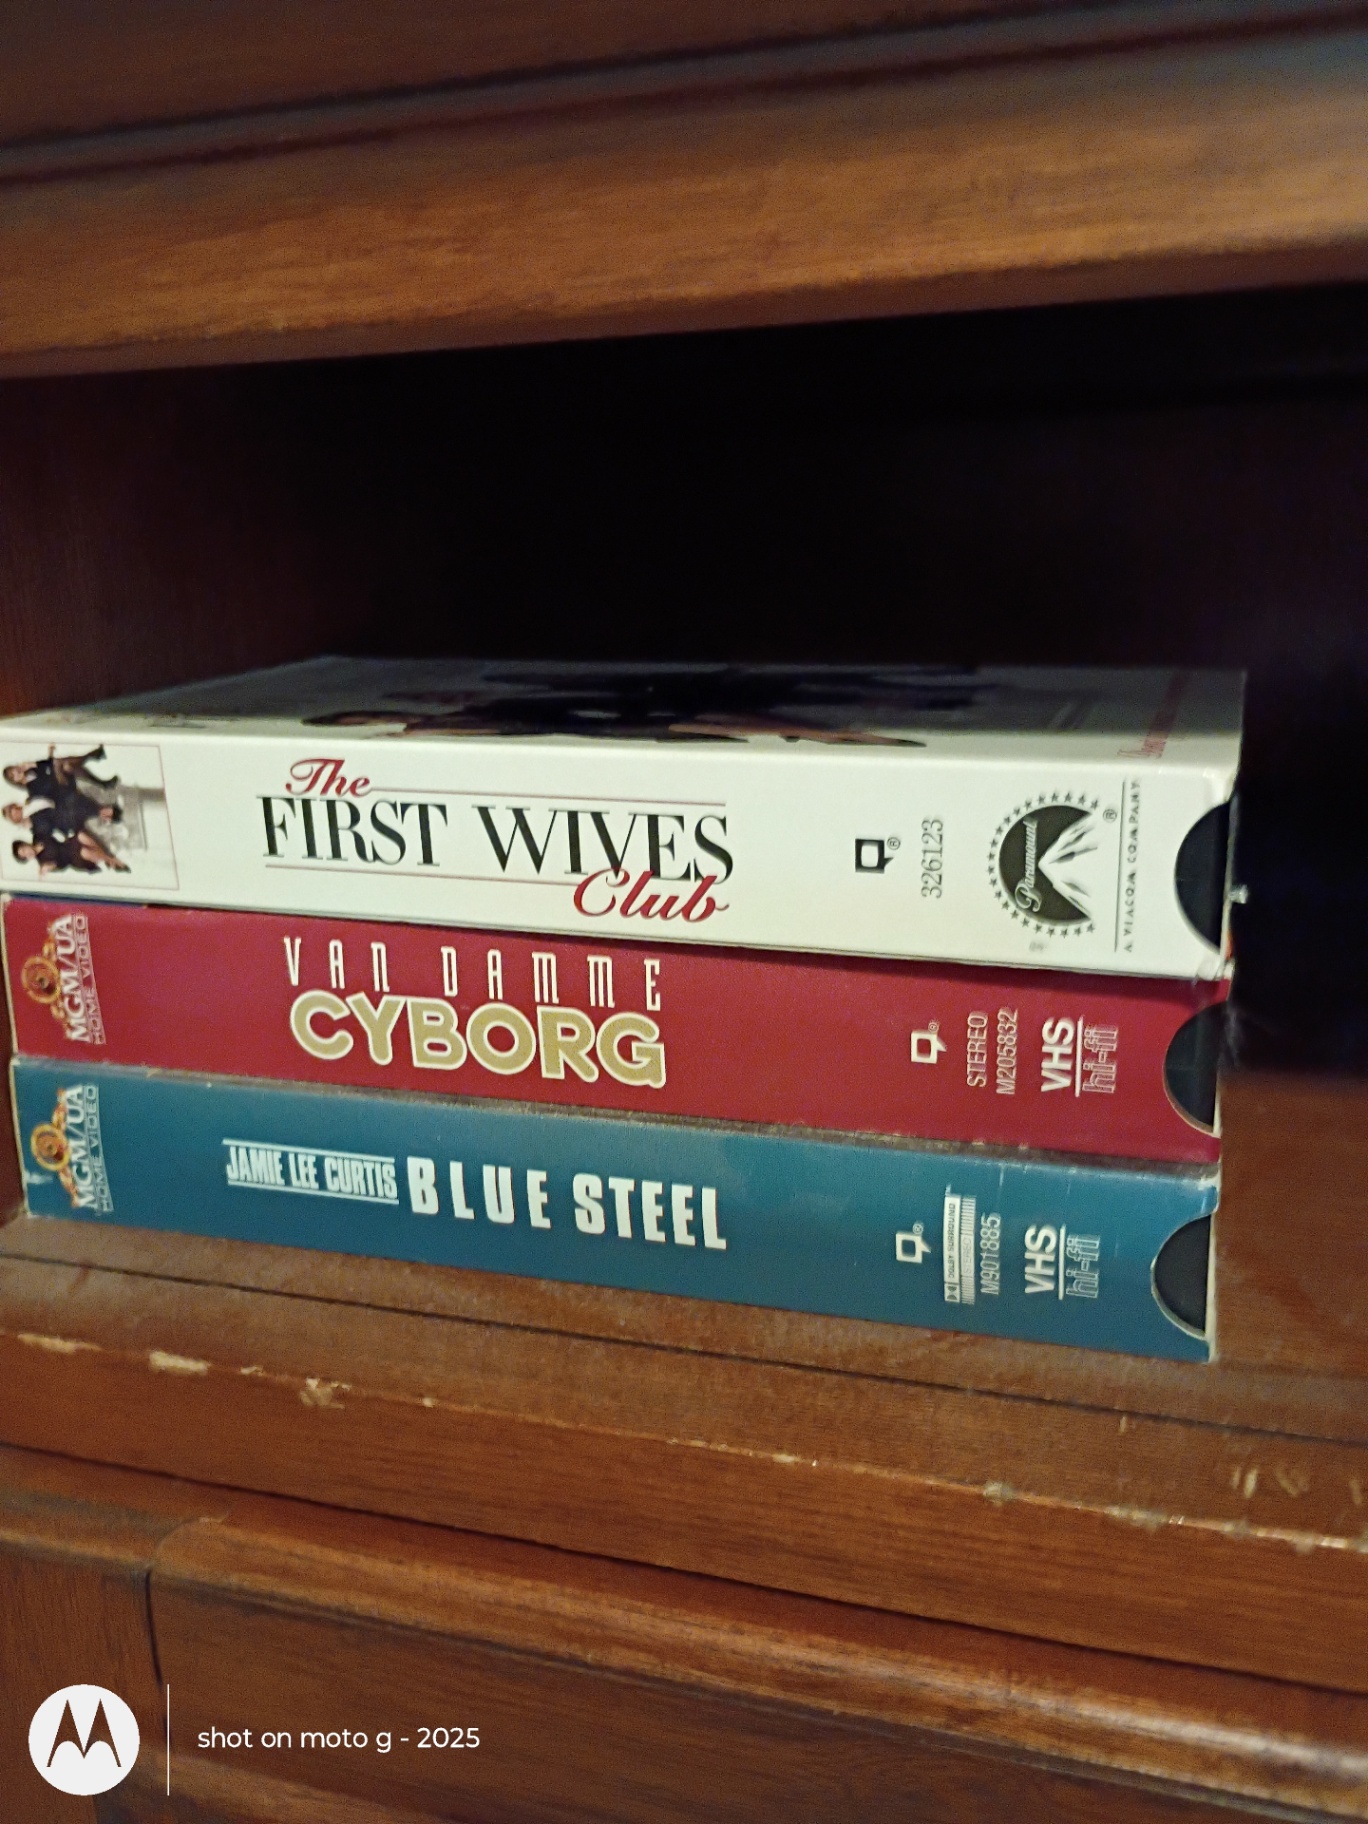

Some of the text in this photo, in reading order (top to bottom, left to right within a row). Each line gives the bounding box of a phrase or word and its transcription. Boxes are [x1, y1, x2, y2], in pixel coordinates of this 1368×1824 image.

[285, 757, 371, 797] The
[256, 794, 734, 885] FIRST WIVES
[920, 816, 945, 899] 326123
[1015, 817, 1042, 912] Paramount
[1123, 780, 1141, 952] A VIACOM COMPANY
[573, 866, 730, 922] Club
[52, 913, 91, 1043] MGM/UA
[75, 914, 91, 979] VIDEO
[283, 936, 661, 1012] VAN DAMME
[290, 988, 667, 1089] CYBORG
[966, 1010, 988, 1088] STEREO
[996, 1006, 1018, 1095] M205832
[1041, 1016, 1075, 1093] VHS
[62, 1083, 98, 1210] MGM/UA
[84, 1084, 101, 1150] VIDEO
[226, 1145, 398, 1200] JAMIE LEE CURTIS
[407, 1156, 728, 1250] BLUE STEEL
[979, 1211, 1001, 1295] M901885
[1024, 1223, 1058, 1294] VHS
